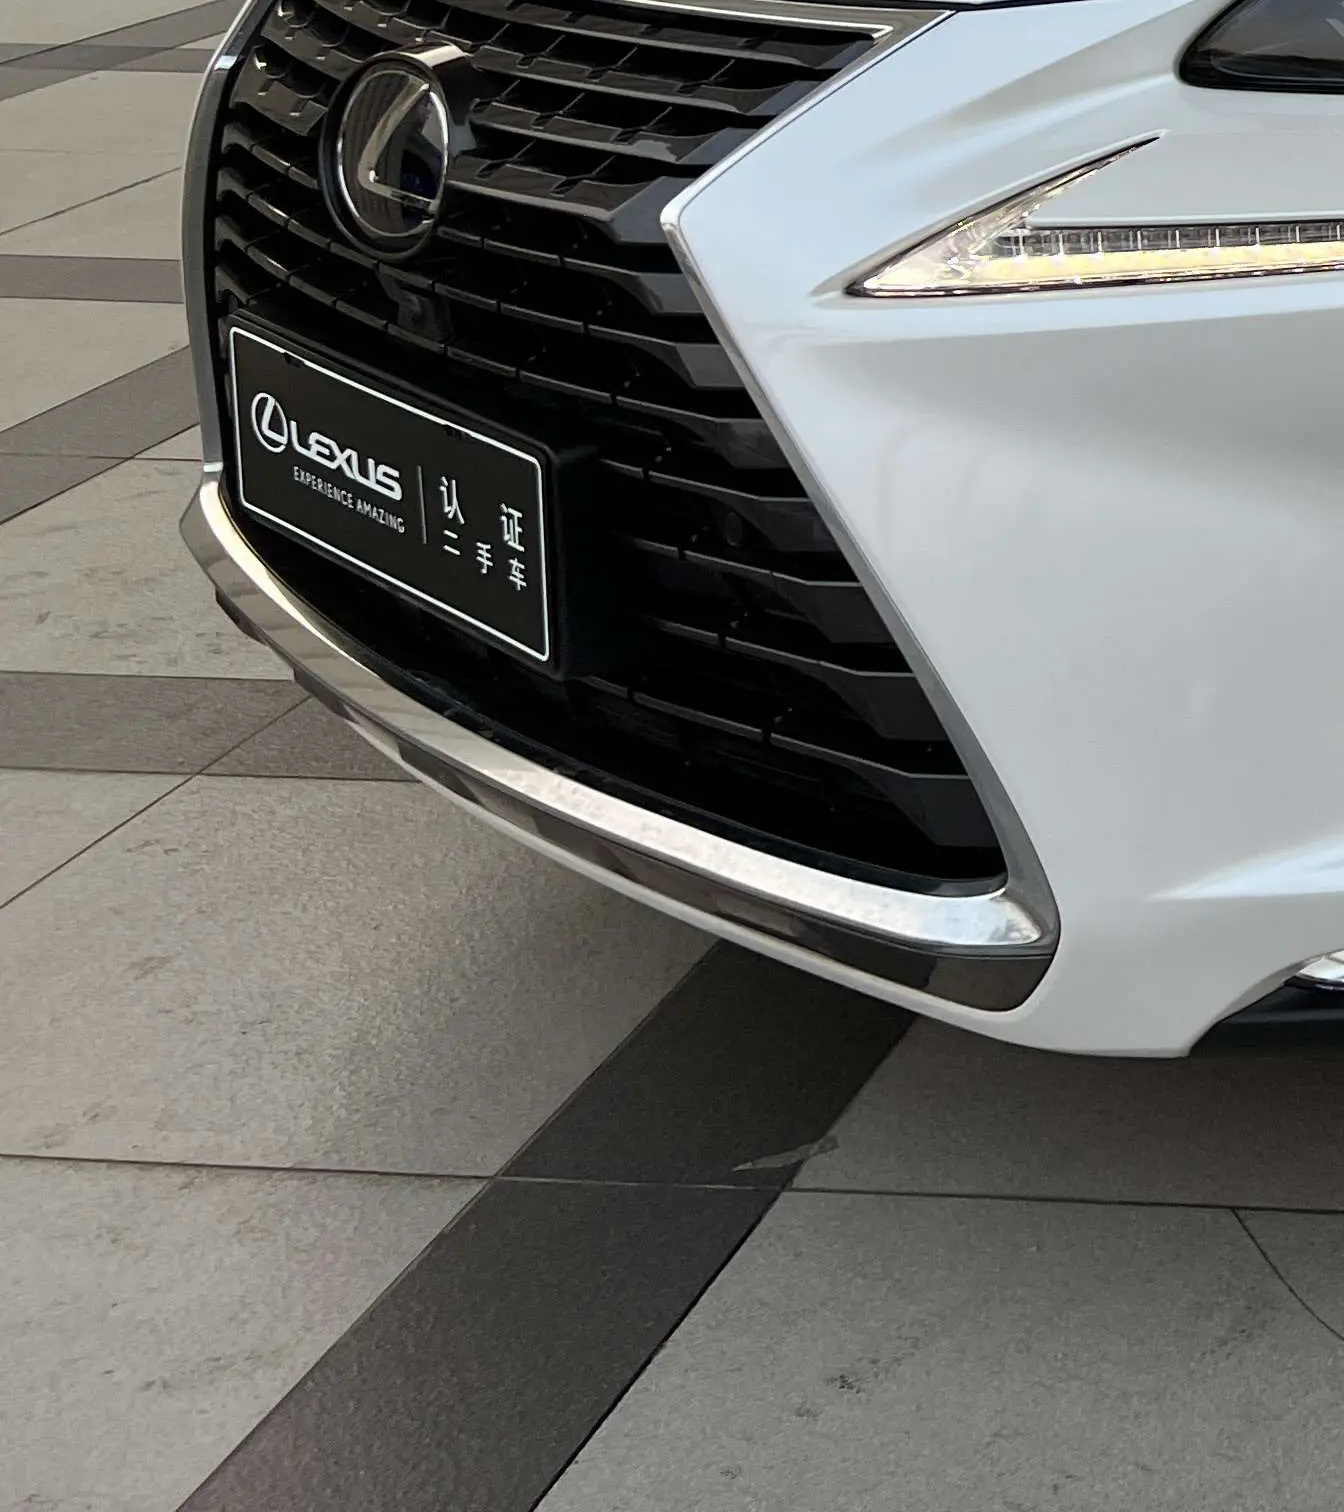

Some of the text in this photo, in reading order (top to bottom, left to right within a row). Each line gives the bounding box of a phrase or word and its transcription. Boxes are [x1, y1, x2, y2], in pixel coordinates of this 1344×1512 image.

[290, 420, 403, 501] LEXUS
[293, 465, 405, 534] EXPERIENCE AMAZING
[439, 475, 525, 552] 认证
[442, 529, 528, 591] 二手车
